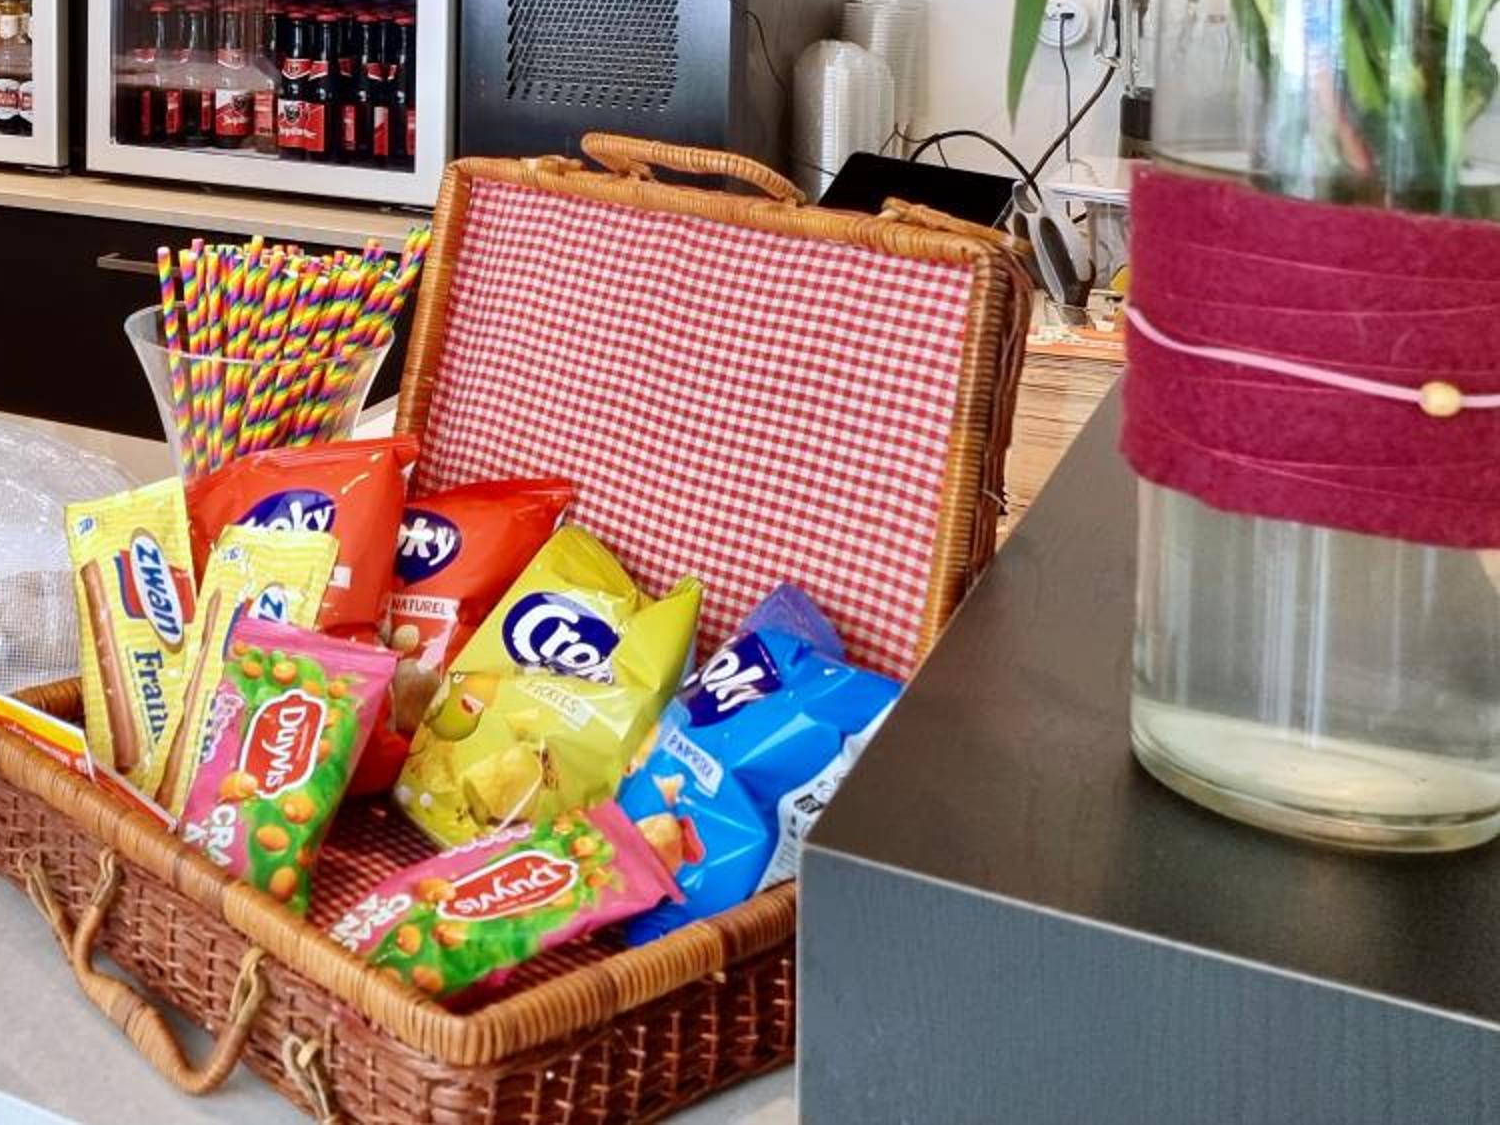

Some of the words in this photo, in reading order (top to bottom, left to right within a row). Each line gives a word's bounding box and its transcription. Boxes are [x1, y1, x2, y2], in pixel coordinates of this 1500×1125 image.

[136, 543, 180, 635] zwan
[392, 597, 451, 616] NATUREL
[262, 704, 308, 788] Duyvis
[453, 863, 564, 914] Duyvis
